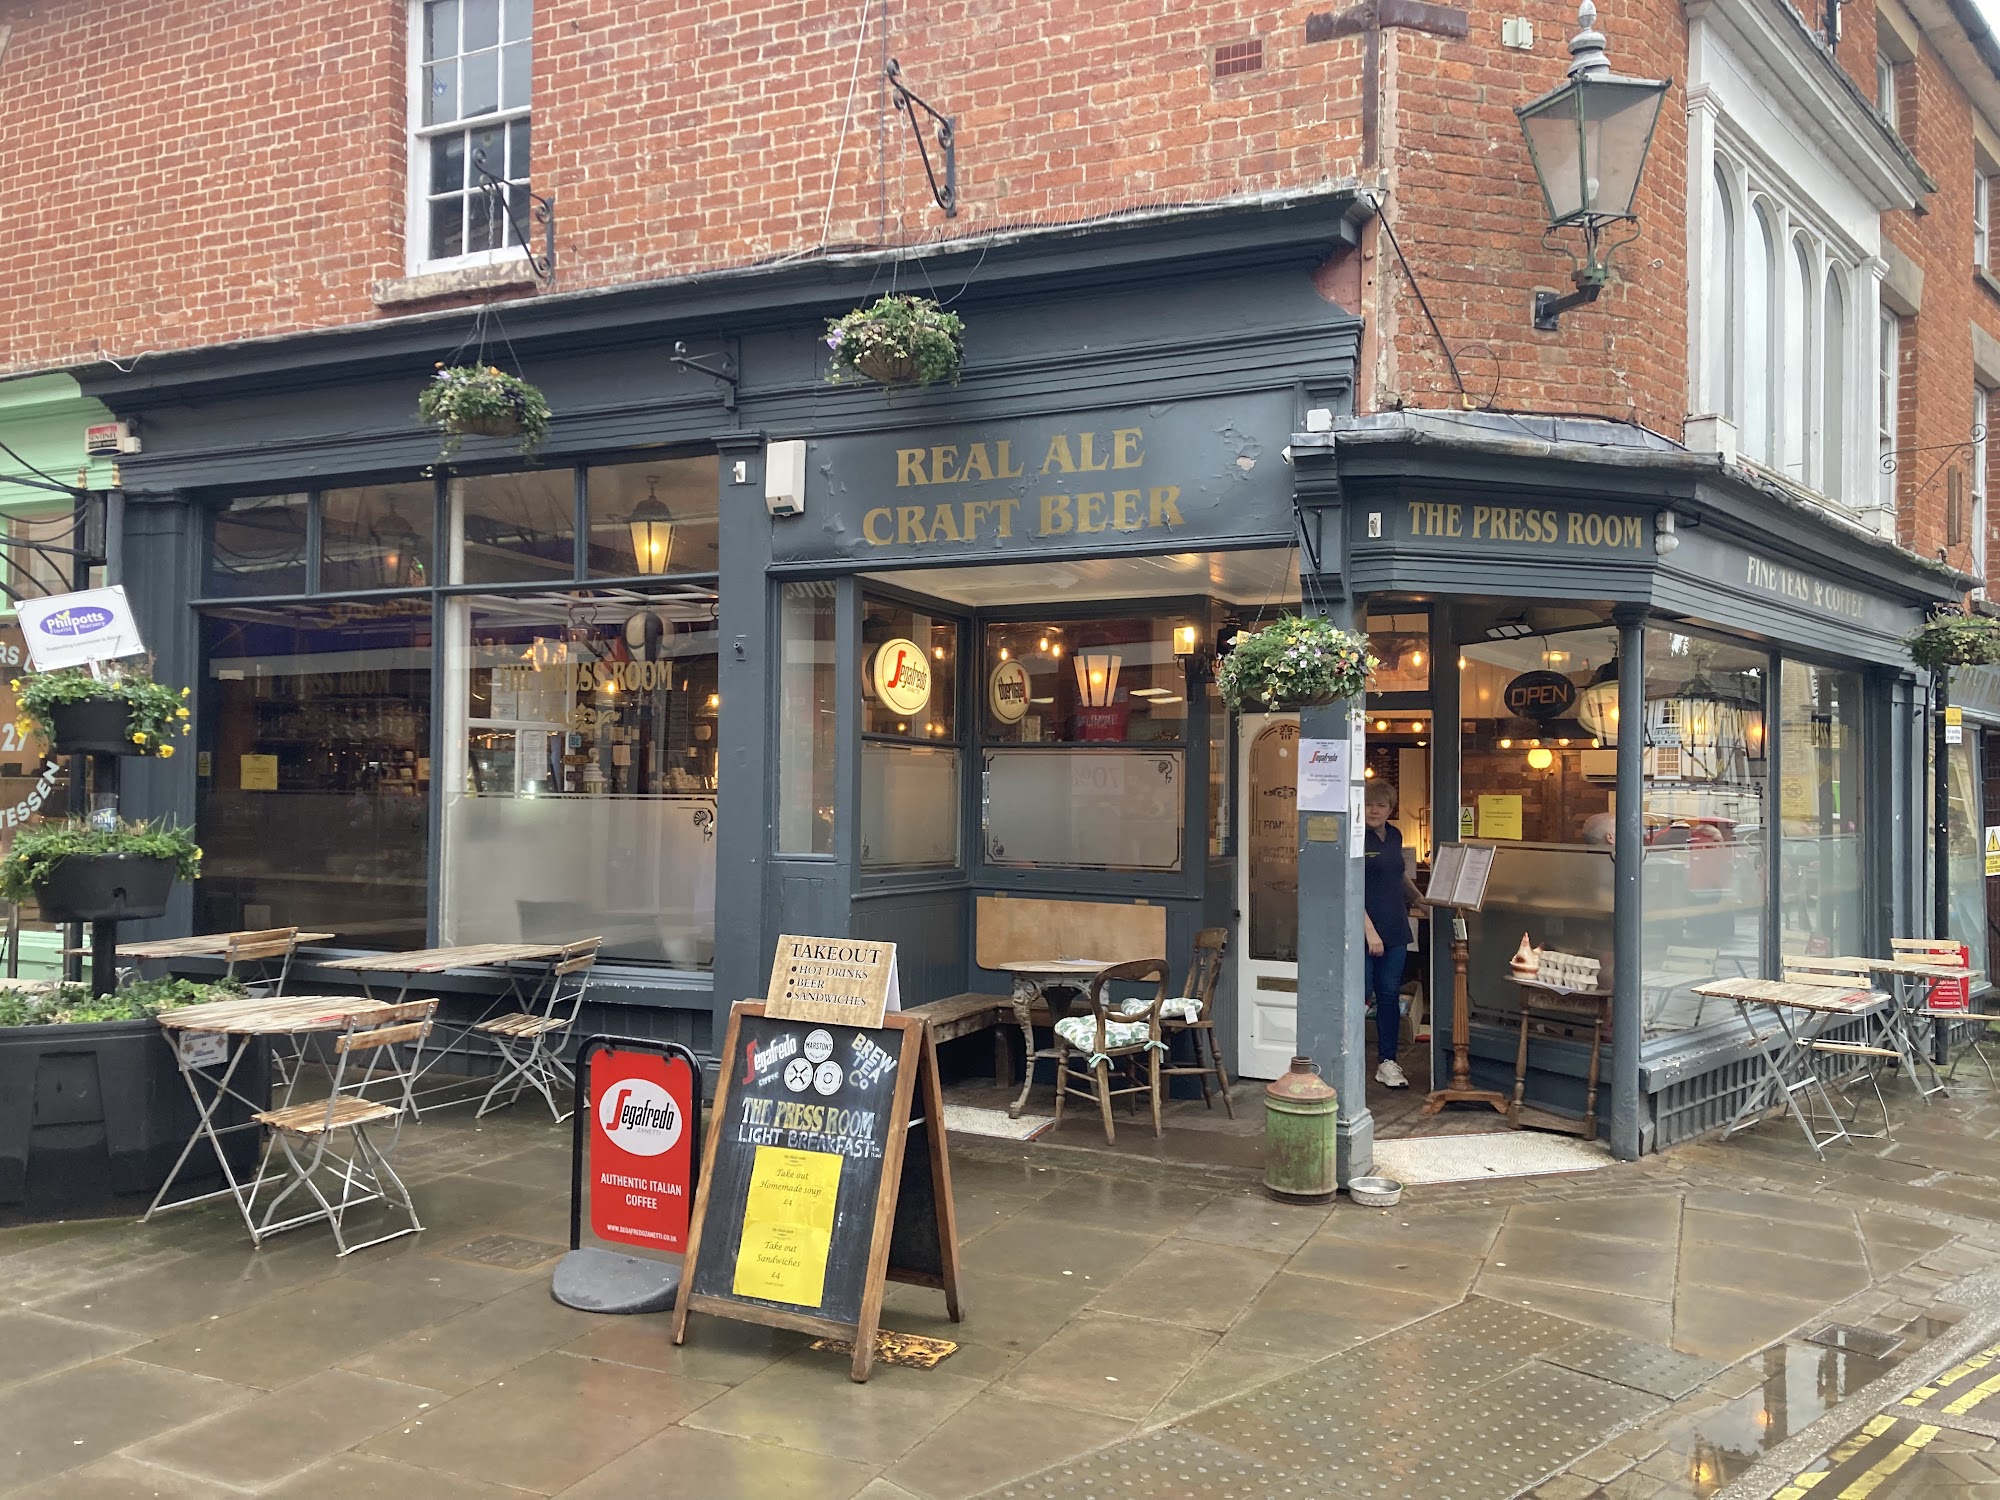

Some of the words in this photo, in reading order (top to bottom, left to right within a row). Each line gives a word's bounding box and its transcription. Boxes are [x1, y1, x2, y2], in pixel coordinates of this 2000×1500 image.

[896, 440, 1025, 487] REAL
[1040, 426, 1146, 475] ALE
[862, 499, 1020, 546] CRAFT
[1039, 485, 1185, 535] BEER
[1408, 502, 1463, 537] THE
[1472, 506, 1559, 543] PRESS
[1566, 512, 1643, 548] ROOM
[1746, 556, 1777, 591] FINE
[1779, 569, 1809, 602] TEAS
[1814, 581, 1823, 607] &
[1825, 586, 1864, 619] COFFEE
[46, 611, 105, 635] Philpotts
[613, 660, 674, 691] ROOM
[887, 650, 928, 690] Segafredo
[1511, 684, 1567, 706] OPEN
[790, 943, 882, 964] TAKEOUT
[796, 978, 824, 989] BEER
[799, 966, 825, 976] HOT
[827, 967, 868, 979] DRINKS
[793, 992, 867, 1006] SANDWICHES
[742, 1034, 797, 1085] Segafredo
[852, 1032, 898, 1074] BREW
[852, 1051, 882, 1084] TEA
[606, 1089, 674, 1131] Segafredo
[742, 1097, 773, 1125] THE
[773, 1101, 825, 1131] PRESS
[825, 1107, 875, 1139] ROOM
[637, 1127, 661, 1135] ZANETTI
[738, 1125, 783, 1145] LIGHT
[787, 1130, 875, 1158] BREAKFAST
[600, 1172, 648, 1191] AUTHENTIC
[649, 1180, 682, 1196] ITALIAN
[776, 1169, 795, 1179] Take
[796, 1172, 809, 1180] out
[759, 1180, 803, 1193] Homemade
[804, 1187, 822, 1197] soup
[625, 1193, 657, 1209] COFFEE
[765, 1241, 783, 1250] Take
[757, 1254, 801, 1267] Sandwiches
[771, 1271, 780, 1279] £4
